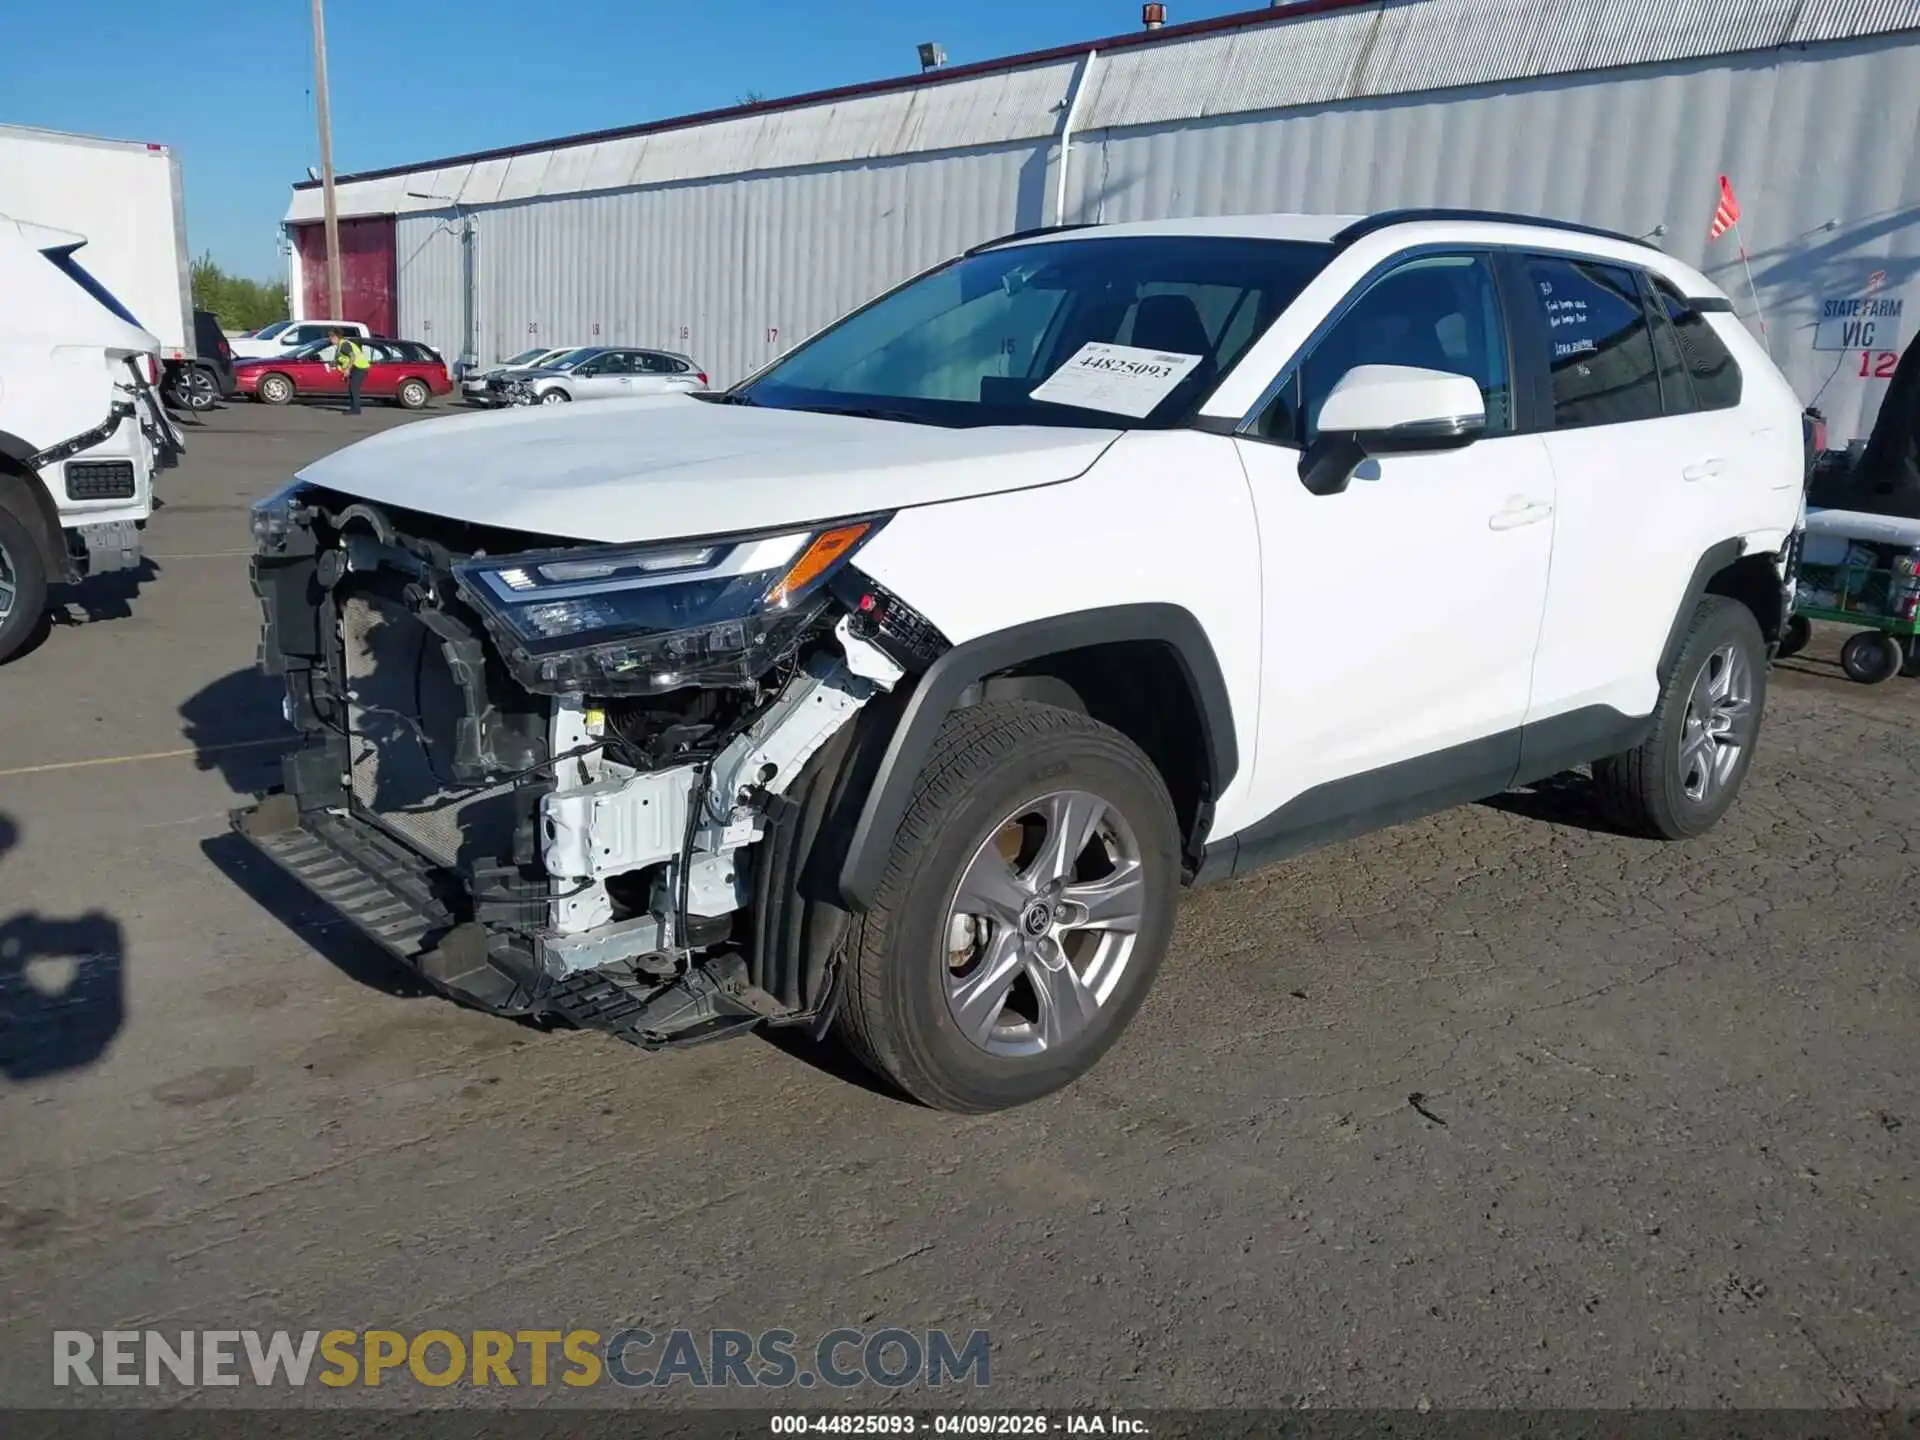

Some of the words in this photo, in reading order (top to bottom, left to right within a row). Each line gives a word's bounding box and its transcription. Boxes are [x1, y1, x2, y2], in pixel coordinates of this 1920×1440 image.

[1823, 299, 1861, 317] STATE
[1863, 299, 1904, 317] FARM
[767, 328, 778, 343] 17
[1843, 321, 1875, 347] VIC
[1080, 356, 1173, 379] 44825093
[1859, 350, 1899, 378] 12
